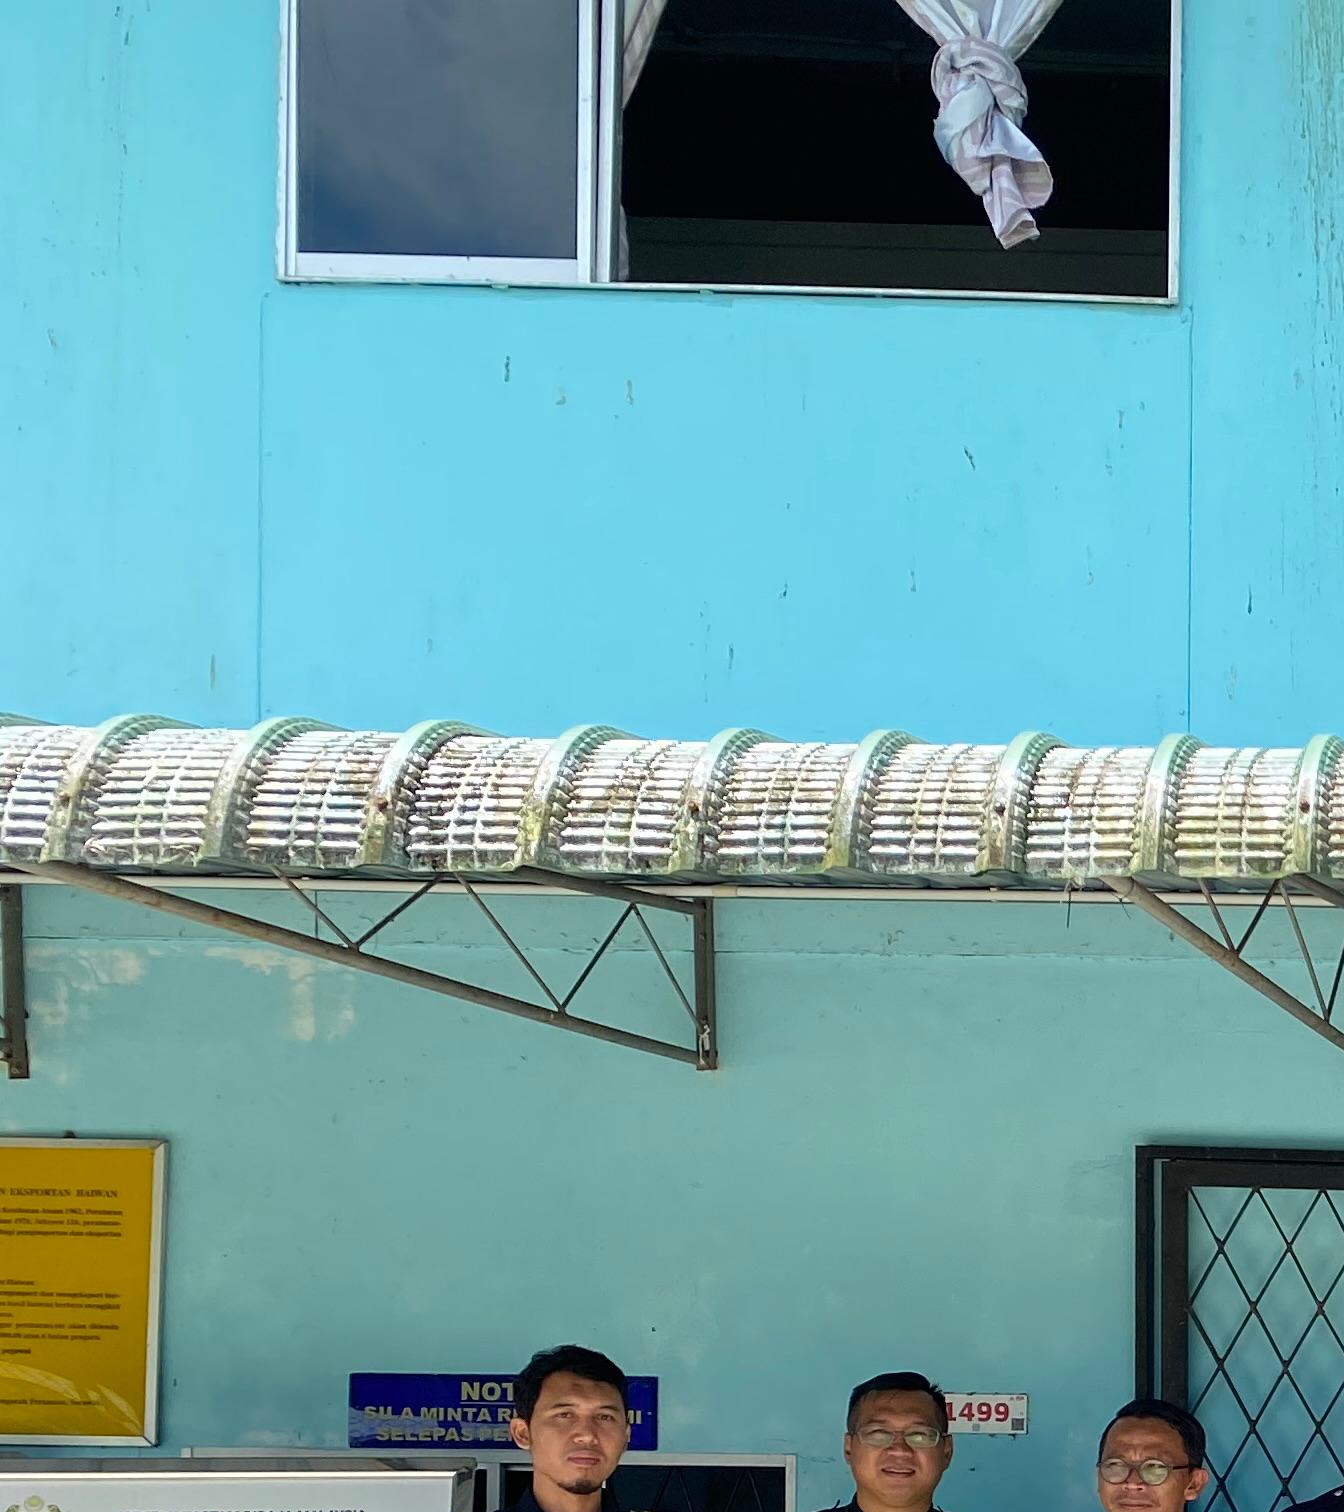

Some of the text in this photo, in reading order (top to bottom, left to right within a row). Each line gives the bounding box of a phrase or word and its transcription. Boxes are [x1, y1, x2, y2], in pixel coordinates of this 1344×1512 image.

[461, 1382, 514, 1401] NOT
[364, 1406, 414, 1420] SILA
[421, 1407, 491, 1421] MINTA
[377, 1427, 513, 1441] SELEPAS PE
